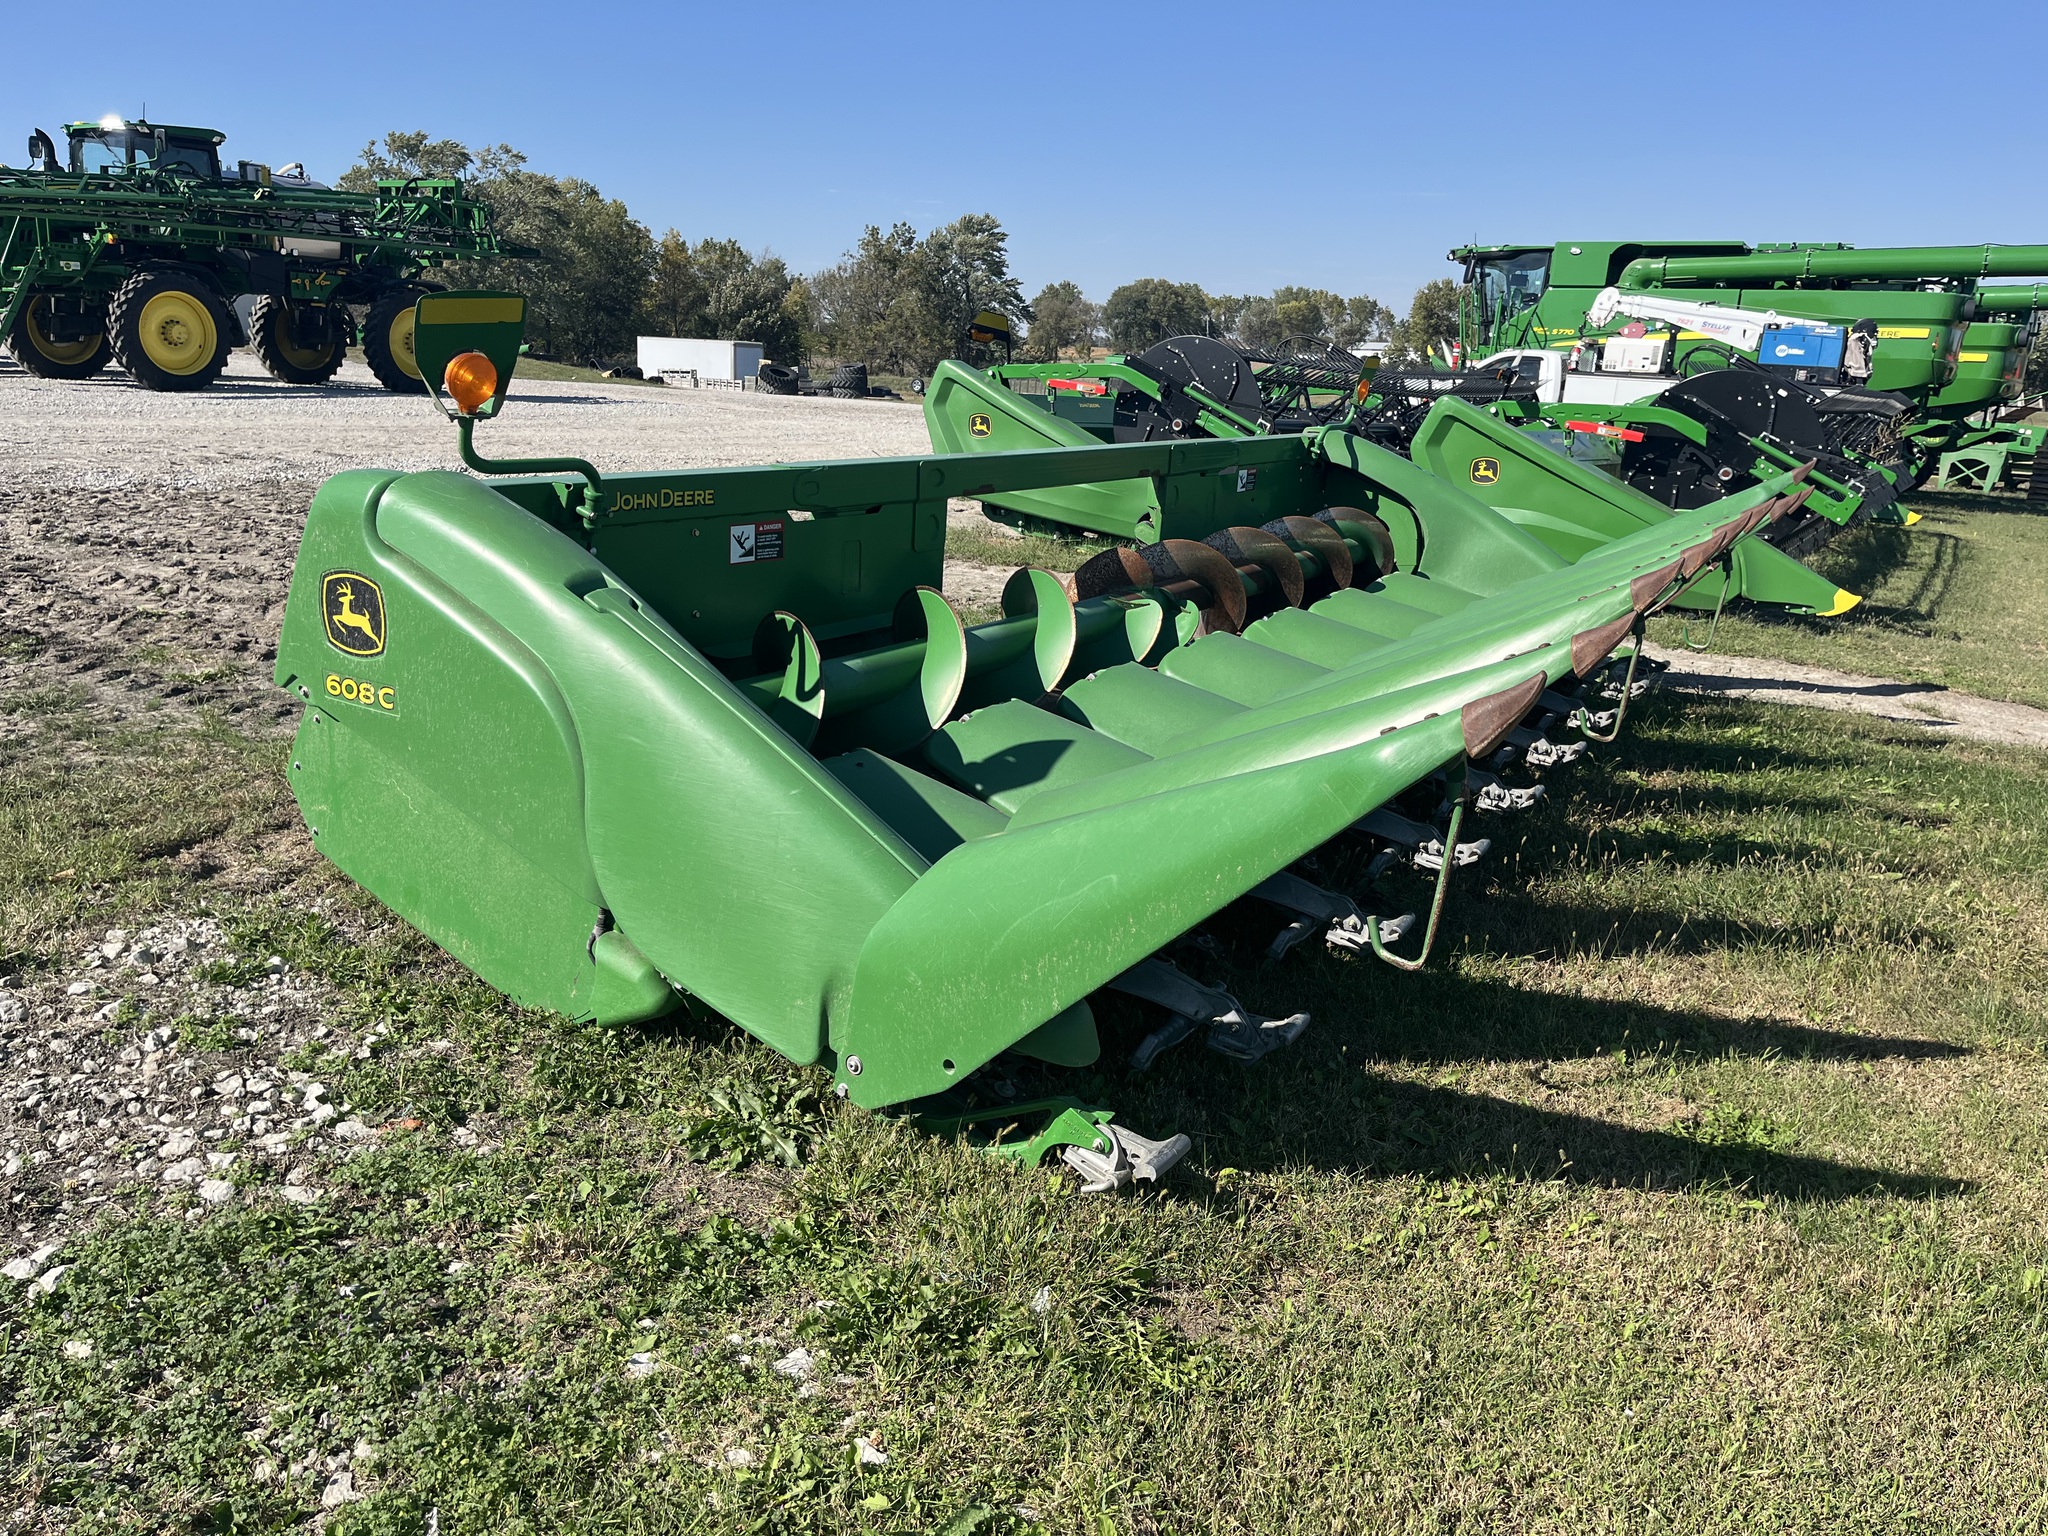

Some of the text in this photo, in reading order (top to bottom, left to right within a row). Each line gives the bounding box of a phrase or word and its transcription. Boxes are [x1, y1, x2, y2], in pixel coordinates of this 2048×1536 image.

[1677, 318, 1694, 326] 7621
[1702, 321, 1731, 332] STELLAR
[611, 489, 715, 512] JOHN DEERE
[763, 523, 782, 531] DANGER
[326, 673, 395, 710] 608C
